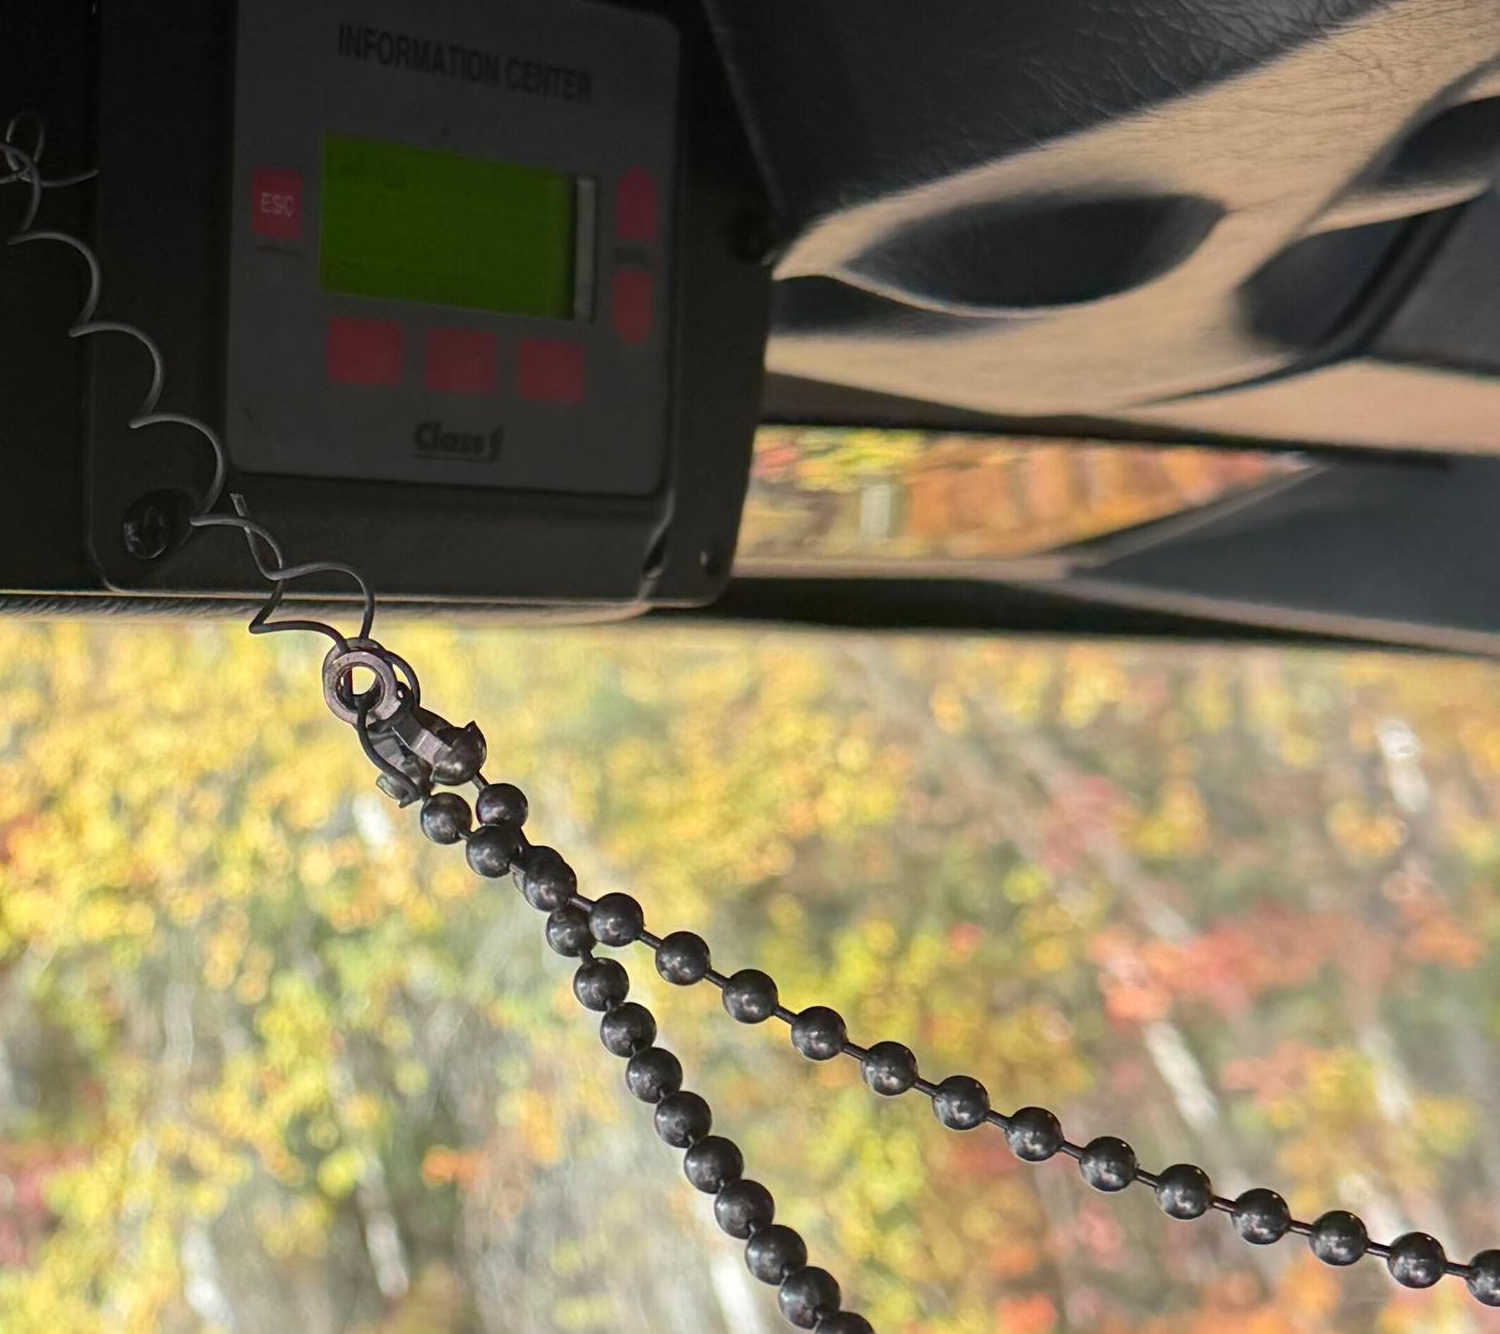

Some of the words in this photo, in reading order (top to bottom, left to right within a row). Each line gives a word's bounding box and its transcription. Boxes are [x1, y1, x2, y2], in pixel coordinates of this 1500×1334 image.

[337, 22, 500, 87] INFORMATION
[505, 57, 592, 104] CENTER
[260, 190, 296, 219] ESC
